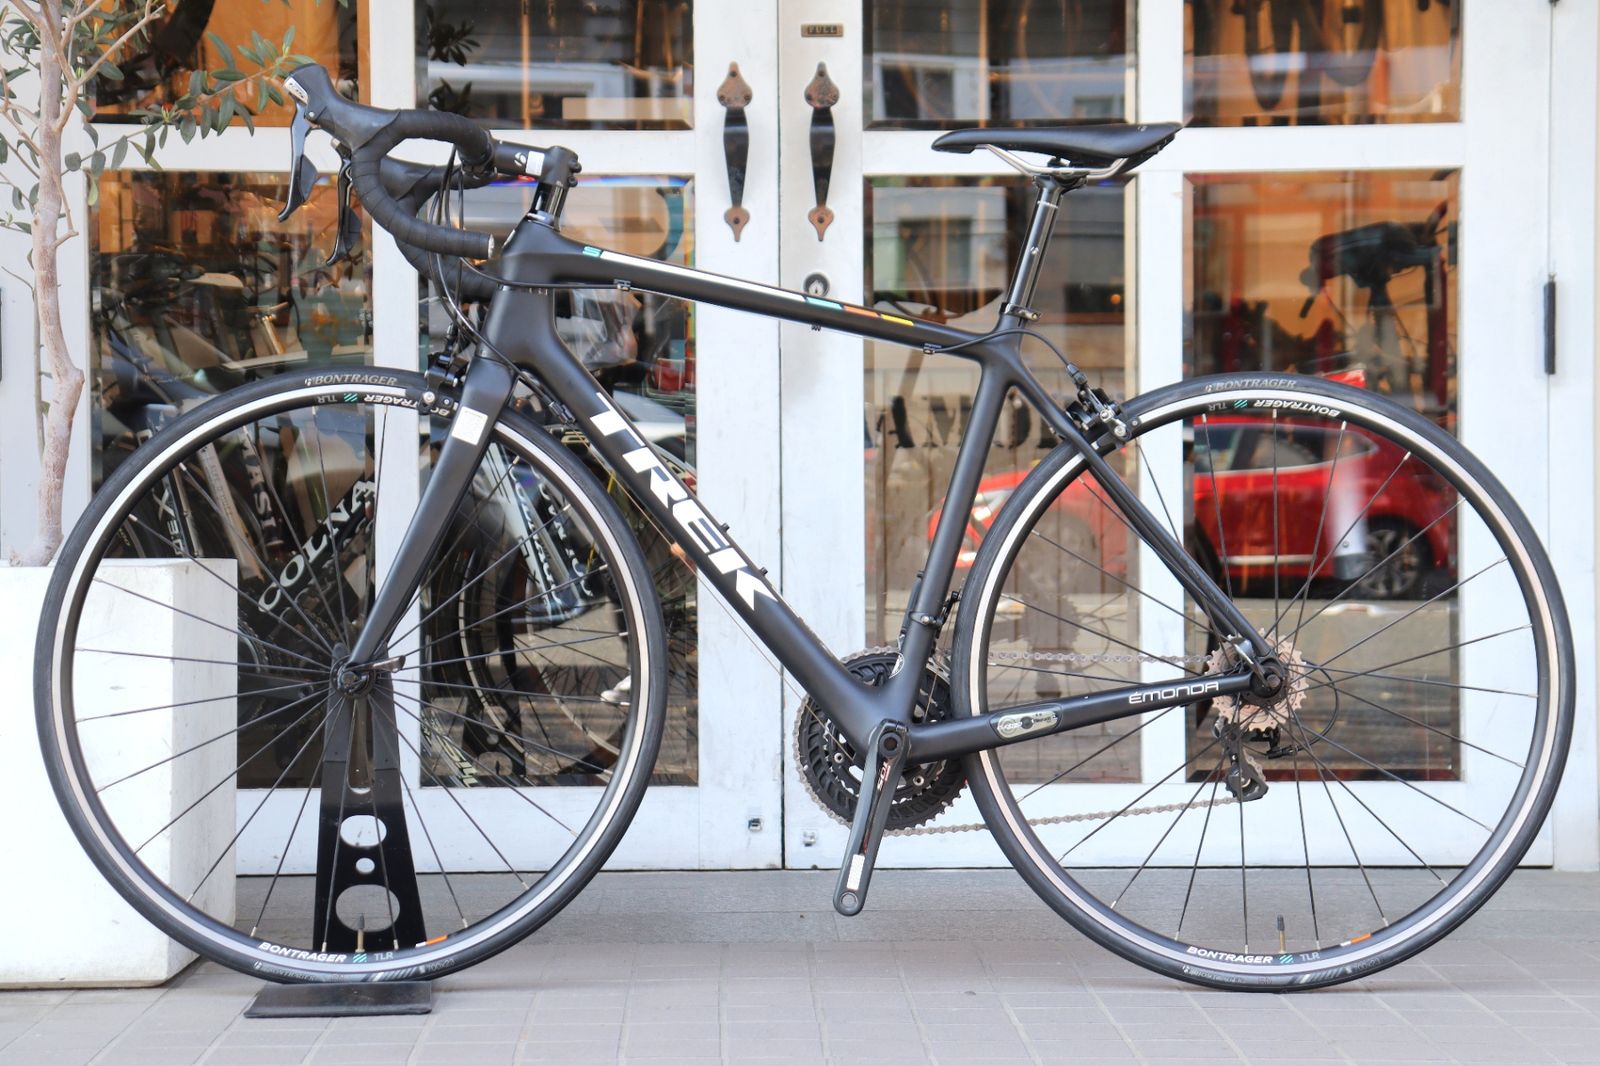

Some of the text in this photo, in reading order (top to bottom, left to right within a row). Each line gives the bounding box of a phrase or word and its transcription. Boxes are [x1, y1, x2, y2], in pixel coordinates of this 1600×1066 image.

[314, 374, 397, 386] BONTRAGER
[1215, 378, 1297, 391] BONTRAGER
[364, 393, 450, 416] BOTRAGER
[1209, 401, 1227, 411] TLR
[1253, 399, 1341, 417] BONTRAGER
[590, 392, 778, 611] TREK
[257, 480, 376, 612] COLNA
[258, 941, 348, 963] BONTRAGER
[374, 952, 394, 961] TLR
[1186, 946, 1274, 964] BONTRAGER
[1300, 953, 1321, 961] TLR
